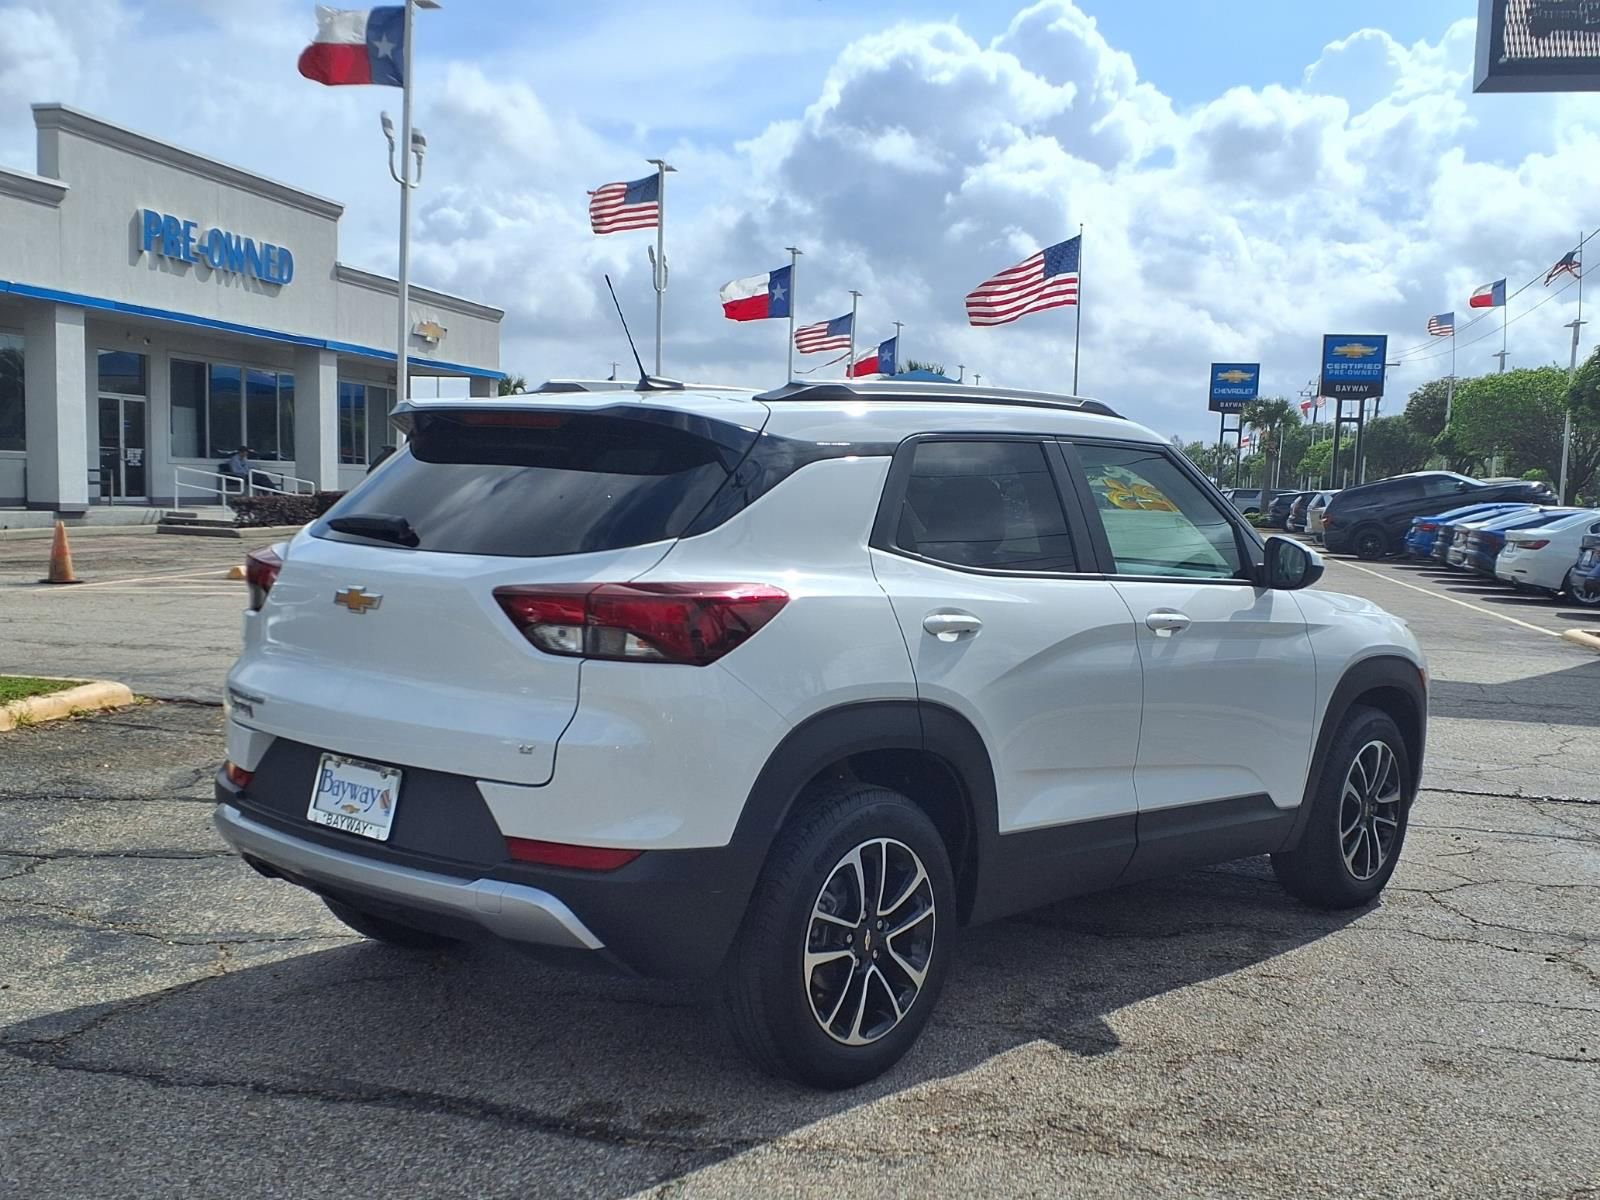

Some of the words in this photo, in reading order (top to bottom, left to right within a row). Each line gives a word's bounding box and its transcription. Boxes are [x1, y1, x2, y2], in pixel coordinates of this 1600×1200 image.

[140, 208, 294, 285] PRE-OWNED
[1213, 387, 1254, 395] CHEVROLET
[1335, 384, 1369, 392] BAYWAY
[319, 768, 381, 813] Bayway
[326, 813, 369, 834] BAYWAY
